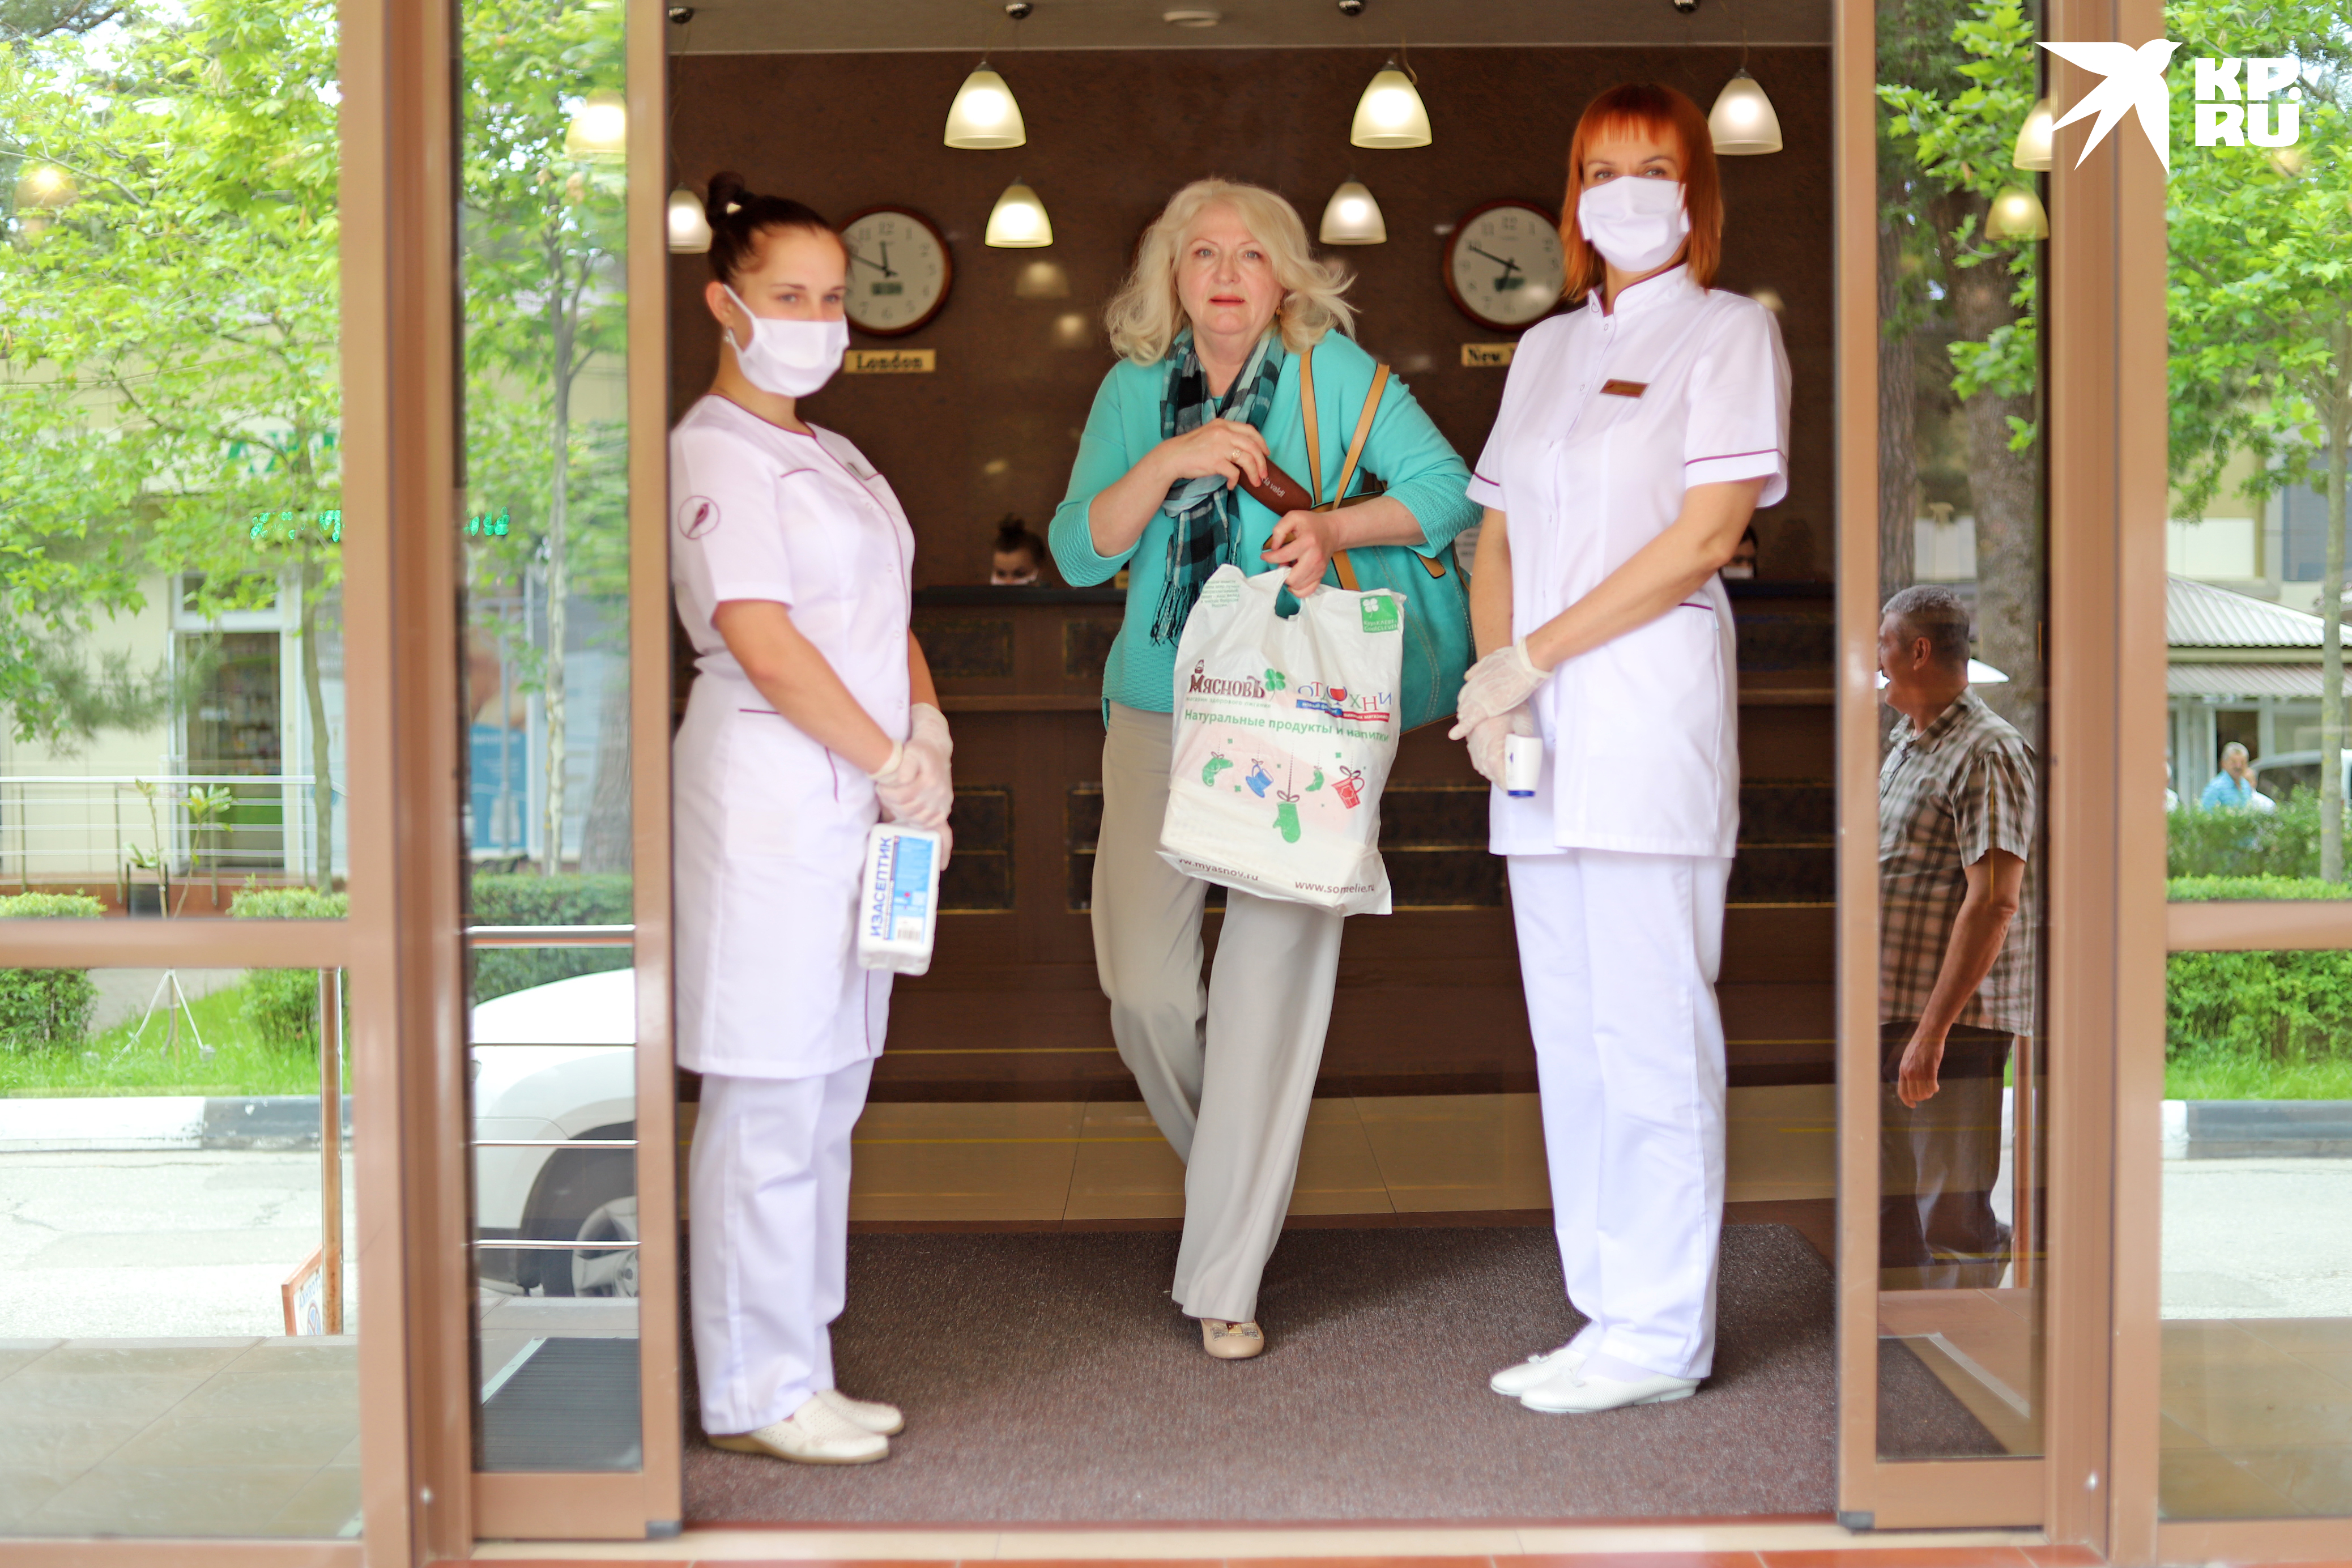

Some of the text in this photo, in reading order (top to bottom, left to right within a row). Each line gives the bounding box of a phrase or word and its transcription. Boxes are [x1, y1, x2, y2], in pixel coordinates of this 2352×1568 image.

[857, 353, 922, 369] London
[1184, 709, 1265, 727] Натуральные
[1269, 719, 1332, 734] продукты
[1347, 728, 1389, 743] напитки
[871, 837, 892, 936] ИЗАСЕПТИК
